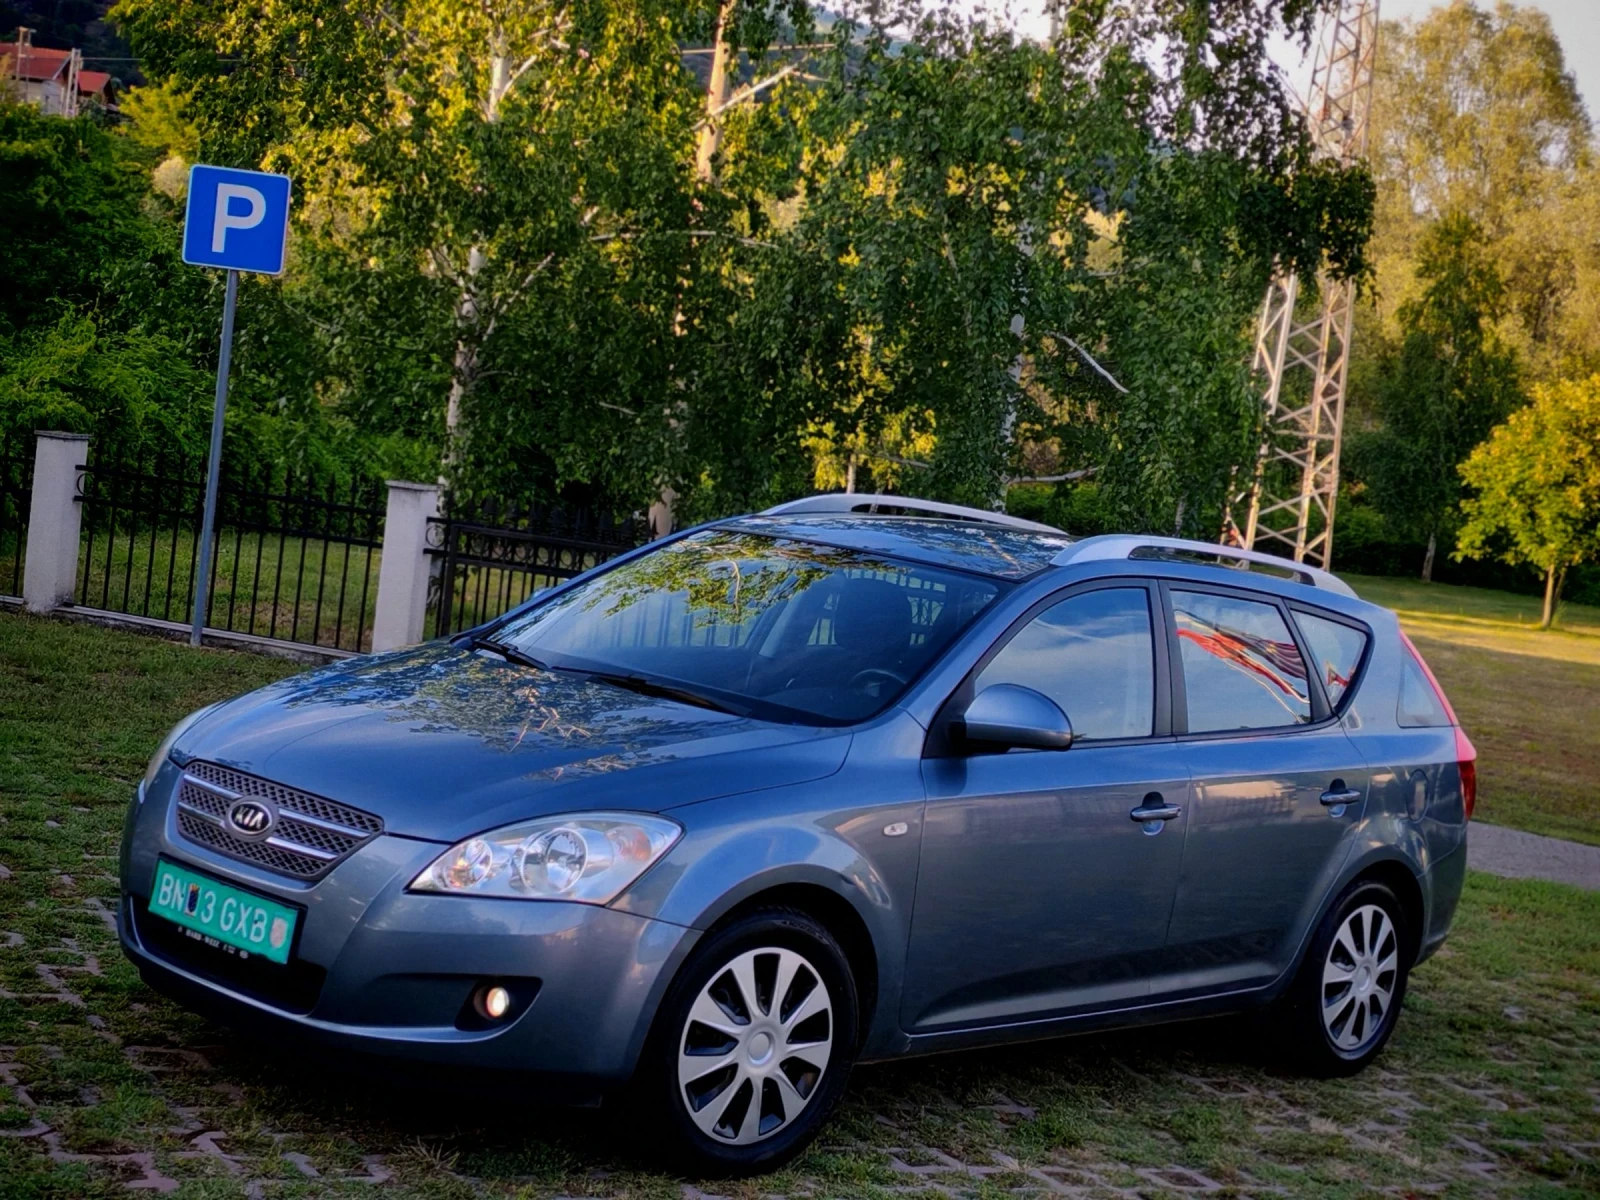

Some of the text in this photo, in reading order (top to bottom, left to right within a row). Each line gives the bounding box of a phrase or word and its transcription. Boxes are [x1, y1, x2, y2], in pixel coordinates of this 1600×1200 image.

[211, 182, 267, 254] P
[234, 806, 265, 830] KIA
[158, 873, 187, 912] BN
